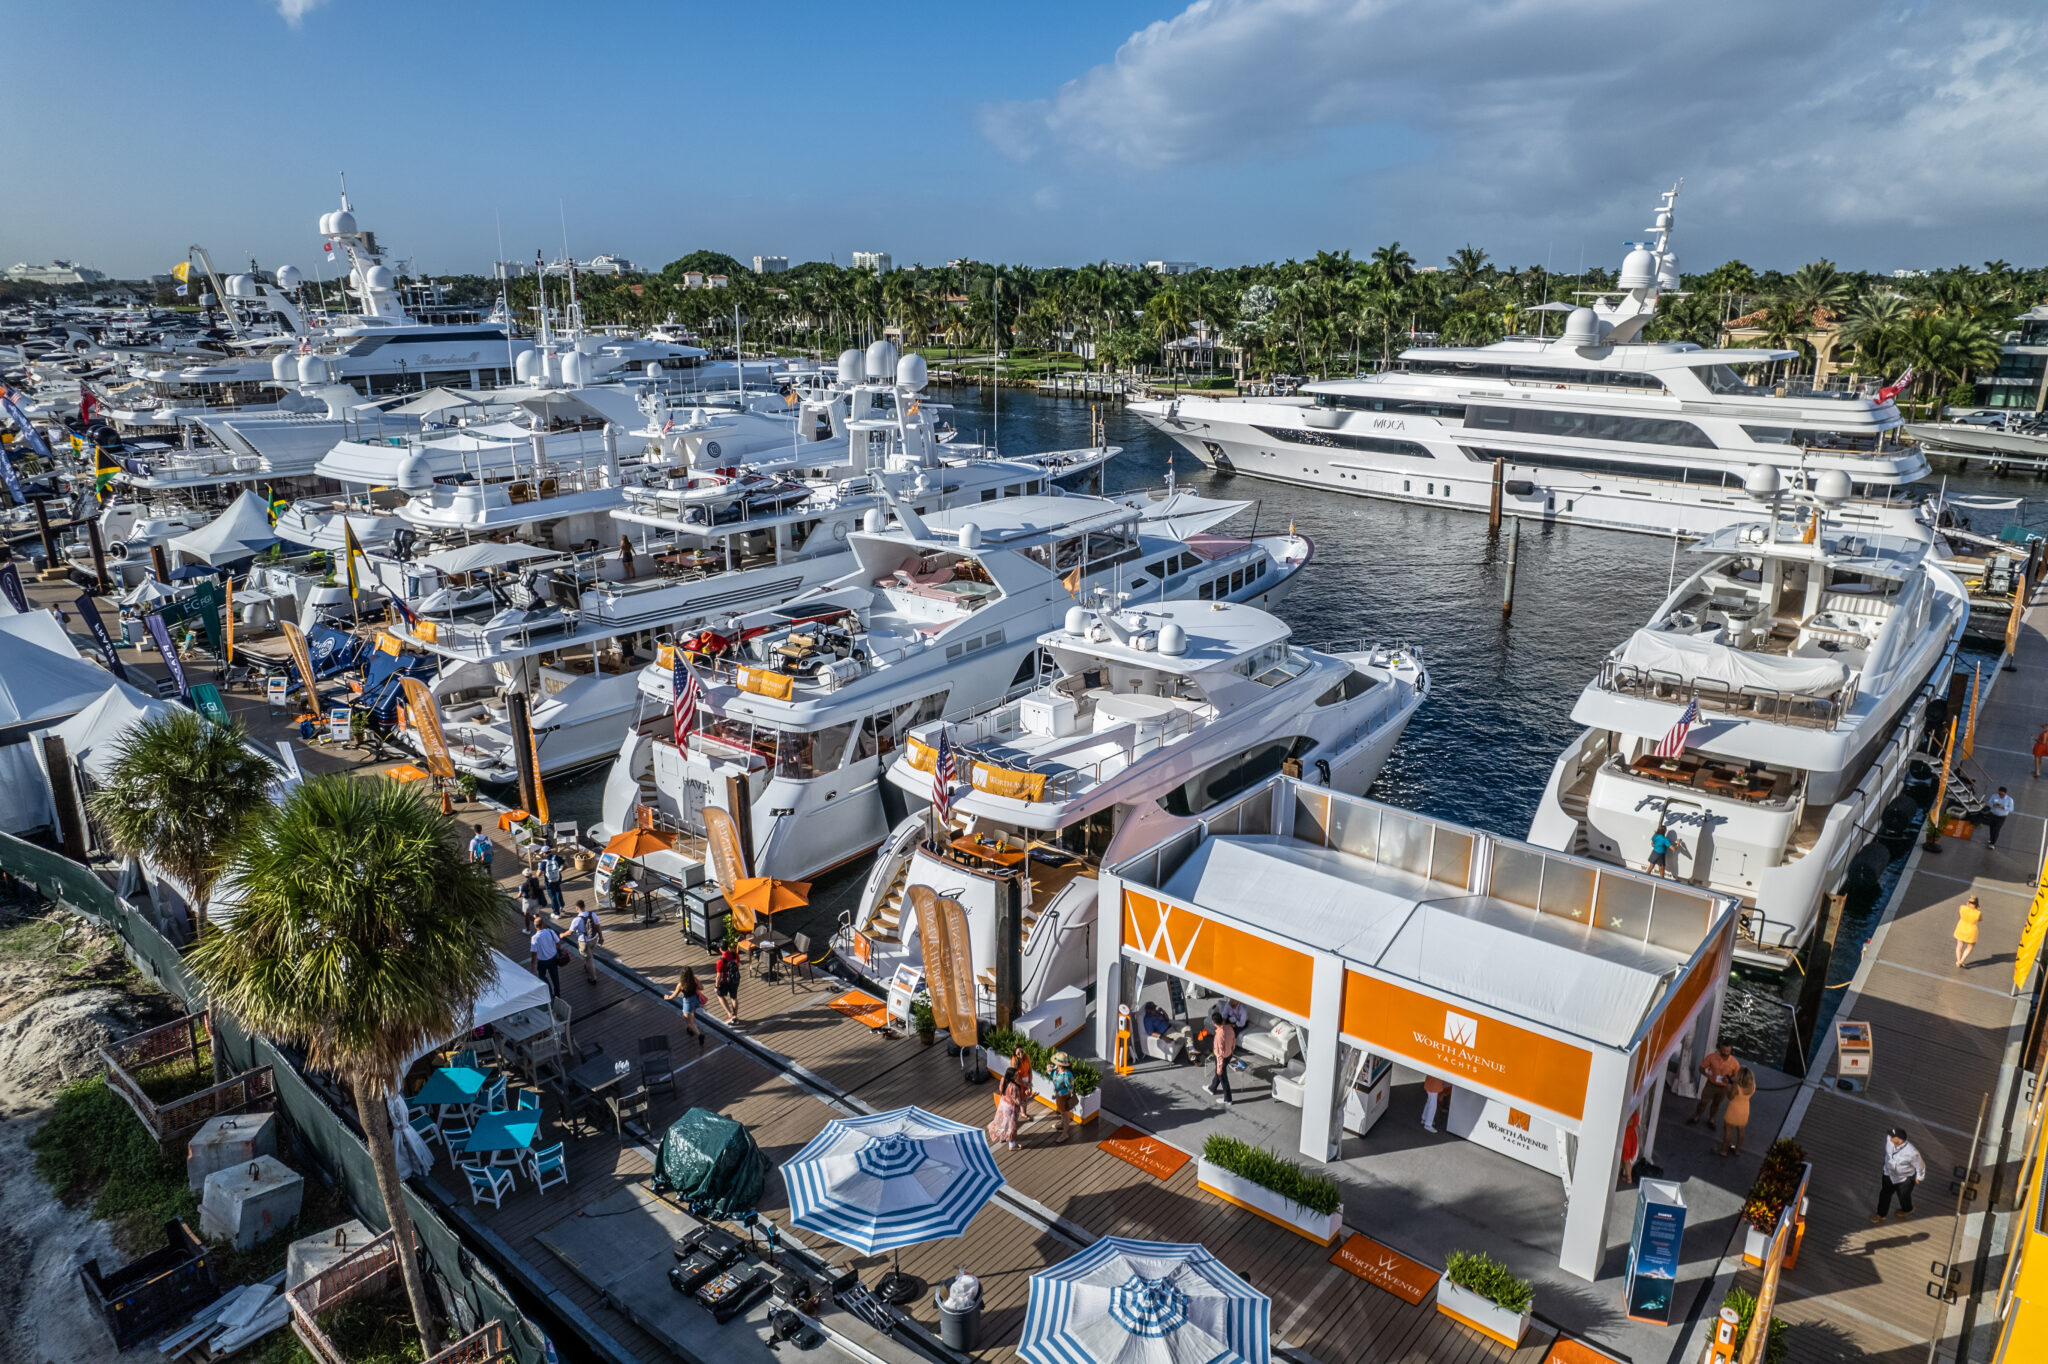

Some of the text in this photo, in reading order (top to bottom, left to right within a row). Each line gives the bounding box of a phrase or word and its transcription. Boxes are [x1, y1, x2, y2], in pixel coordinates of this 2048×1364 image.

[1374, 418, 1405, 431] MOCA
[683, 776, 715, 796] HAVEN
[989, 775, 1013, 788] WORTH
[1413, 1031, 1506, 1074] WORTH AVENUE
[1437, 1054, 1478, 1073] YACHTS
[1487, 1120, 1549, 1151] WORTH AVENUE
[1503, 1136, 1530, 1150] YACHTS
[1341, 1249, 1423, 1297] WORTH AVENUE
